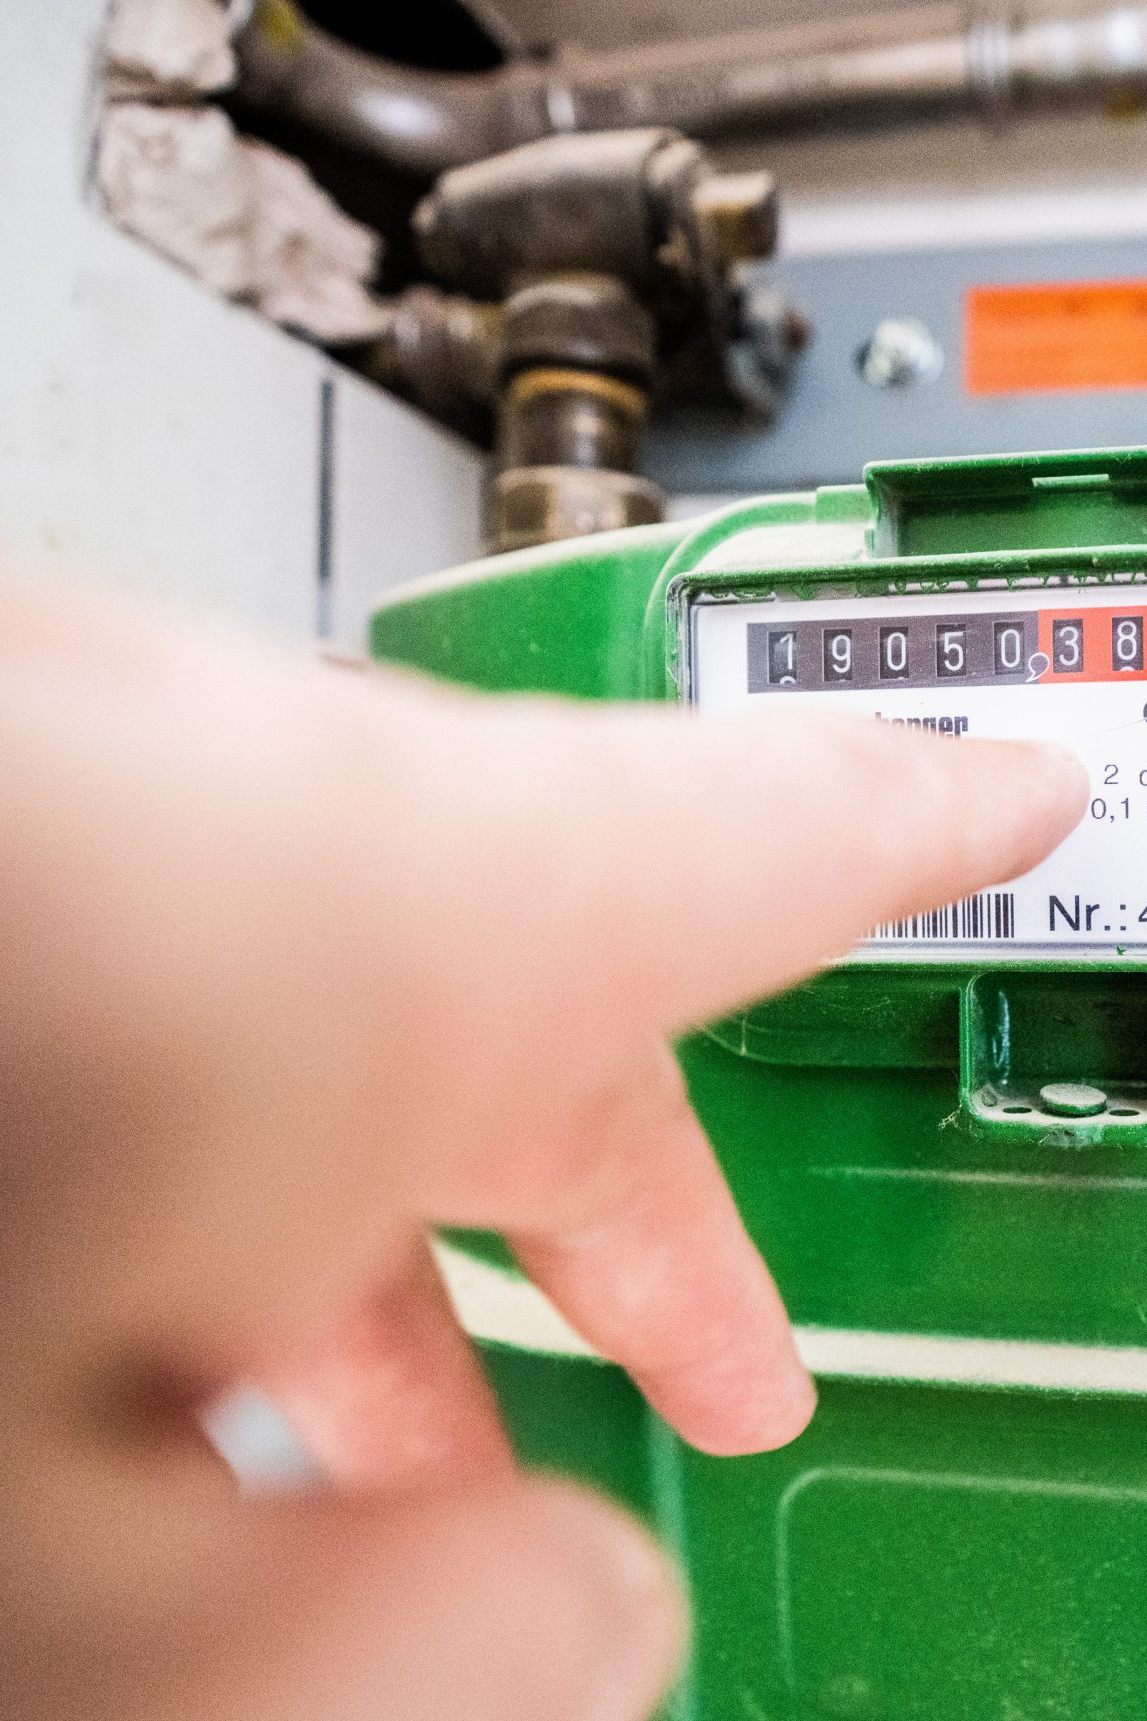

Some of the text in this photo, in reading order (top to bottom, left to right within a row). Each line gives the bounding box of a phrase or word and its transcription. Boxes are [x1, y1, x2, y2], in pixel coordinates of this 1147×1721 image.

[1103, 764, 1119, 785] 2
[1091, 798, 1130, 822] 0,1
[1049, 894, 1127, 931] Nr.:
